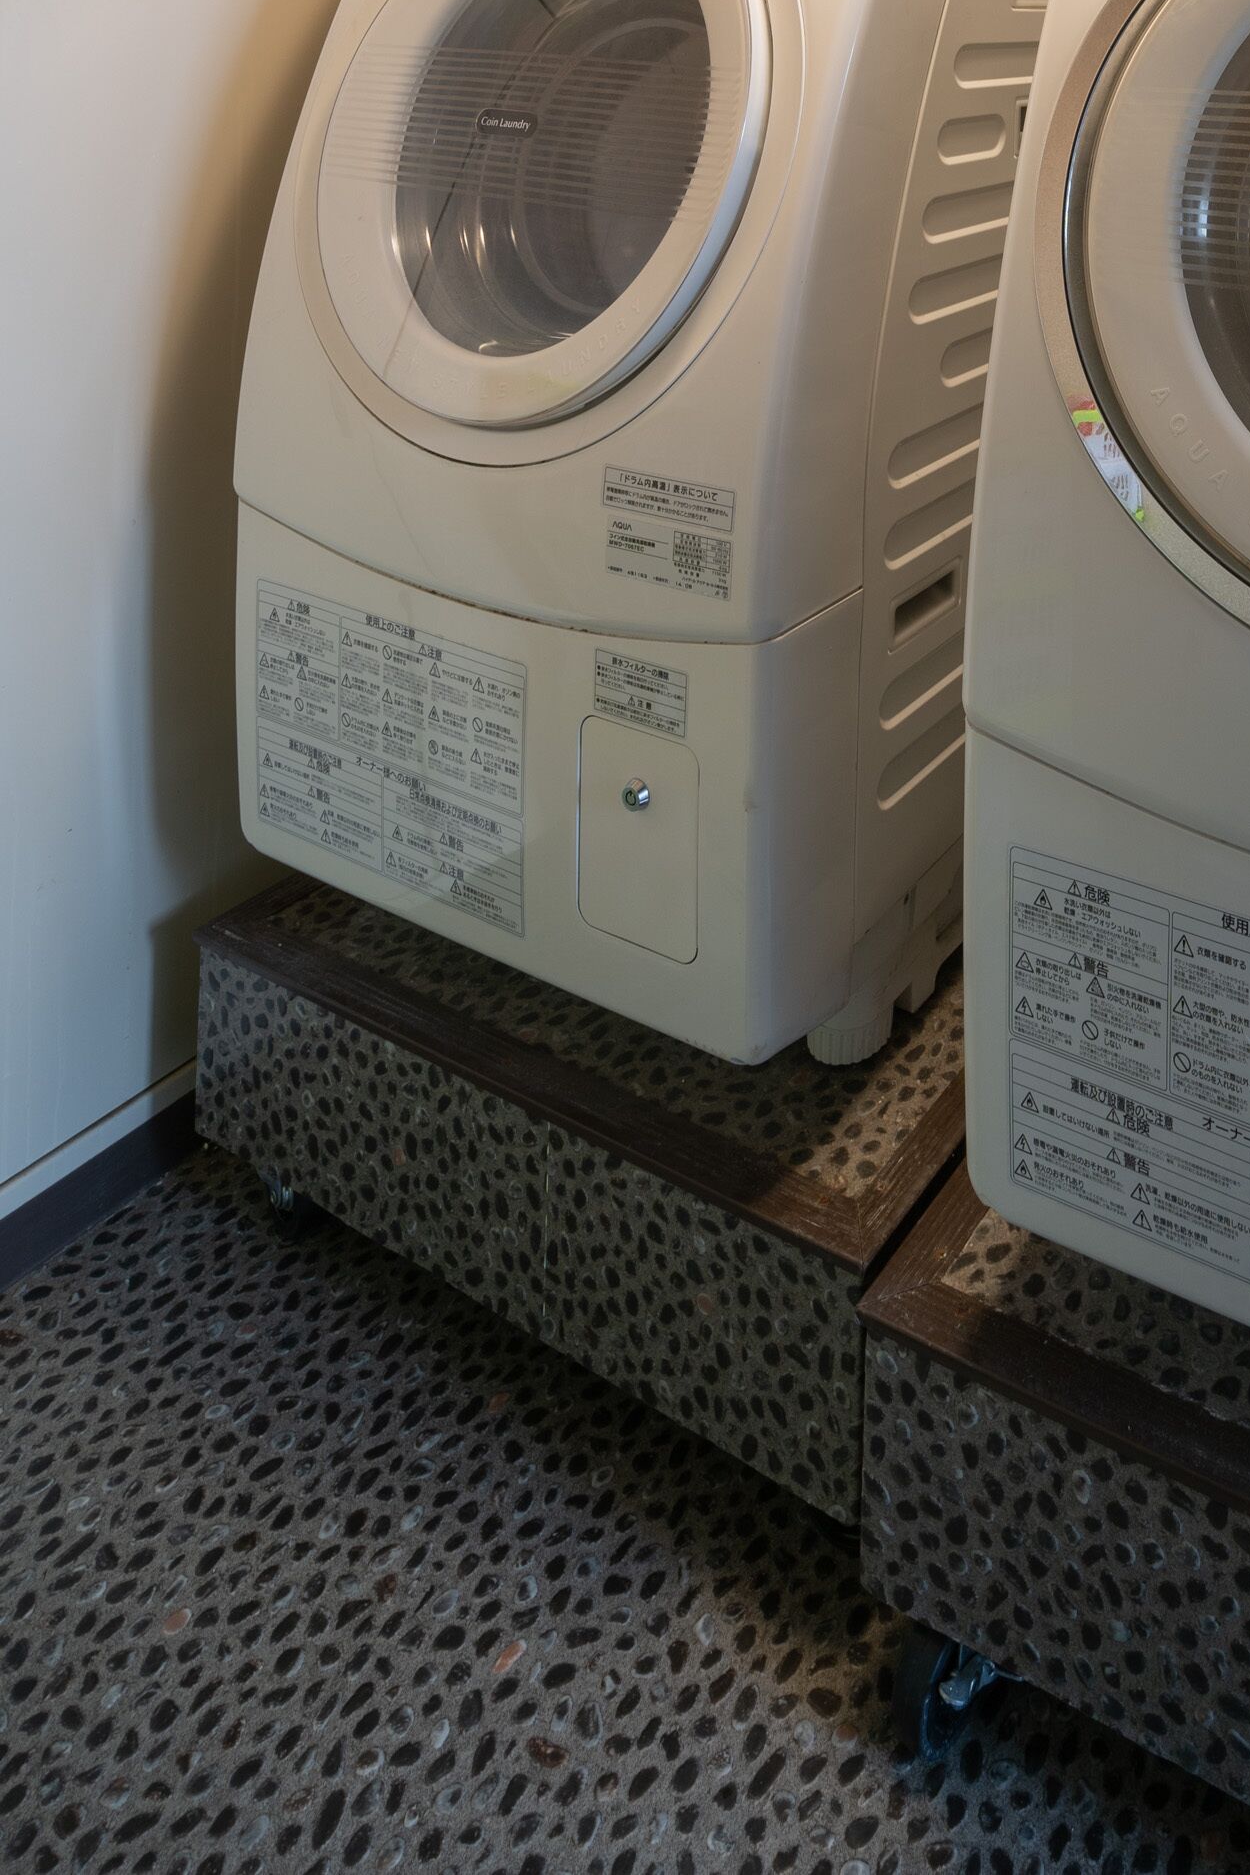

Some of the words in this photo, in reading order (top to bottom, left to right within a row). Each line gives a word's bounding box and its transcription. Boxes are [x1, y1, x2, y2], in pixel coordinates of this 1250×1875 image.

[481, 117, 498, 126] Coin
[500, 118, 531, 132] Laundry
[1150, 386, 1229, 492] AQUA
[612, 521, 632, 531] AQUA
[1084, 885, 1111, 908] 危険
[1083, 956, 1109, 979] 警告
[1070, 1076, 1174, 1132] 運転及び設置時のご注意
[1122, 1114, 1150, 1138] 危険
[1123, 1151, 1150, 1176] 警告
